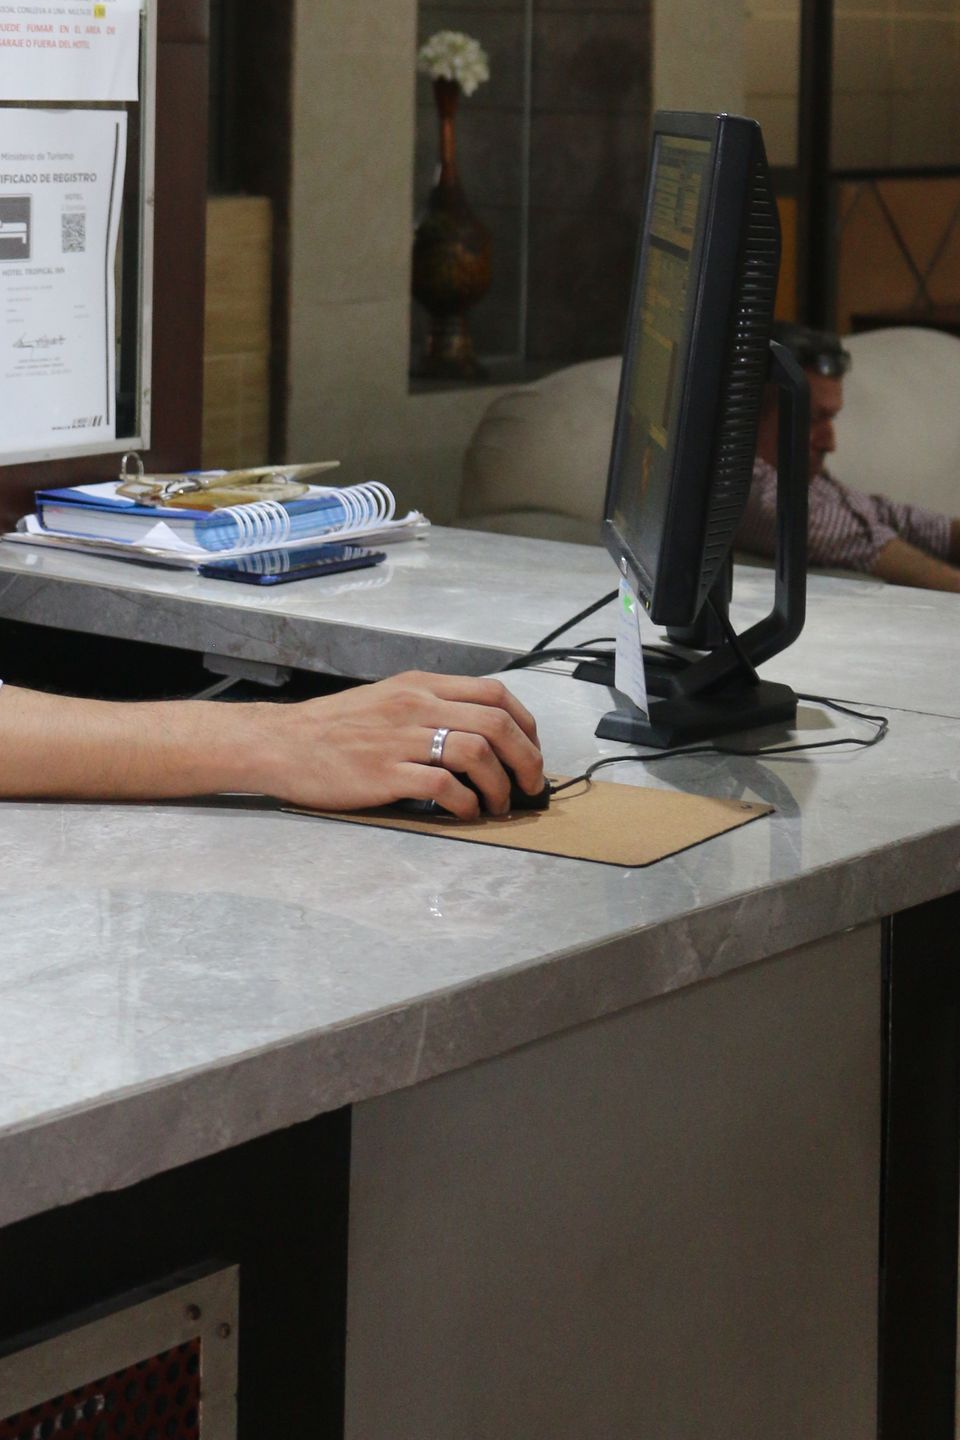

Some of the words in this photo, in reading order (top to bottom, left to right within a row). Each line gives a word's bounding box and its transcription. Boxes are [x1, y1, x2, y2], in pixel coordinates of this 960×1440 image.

[26, 24, 53, 33] FUMAR
[60, 25, 69, 33] EN
[26, 39, 32, 48] O
[33, 39, 56, 48] FUERA
[59, 40, 71, 48] DEL
[37, 153, 45, 161] de
[47, 152, 74, 160] Turismo
[40, 174, 51, 184] DE
[53, 173, 97, 183] REGISTRO
